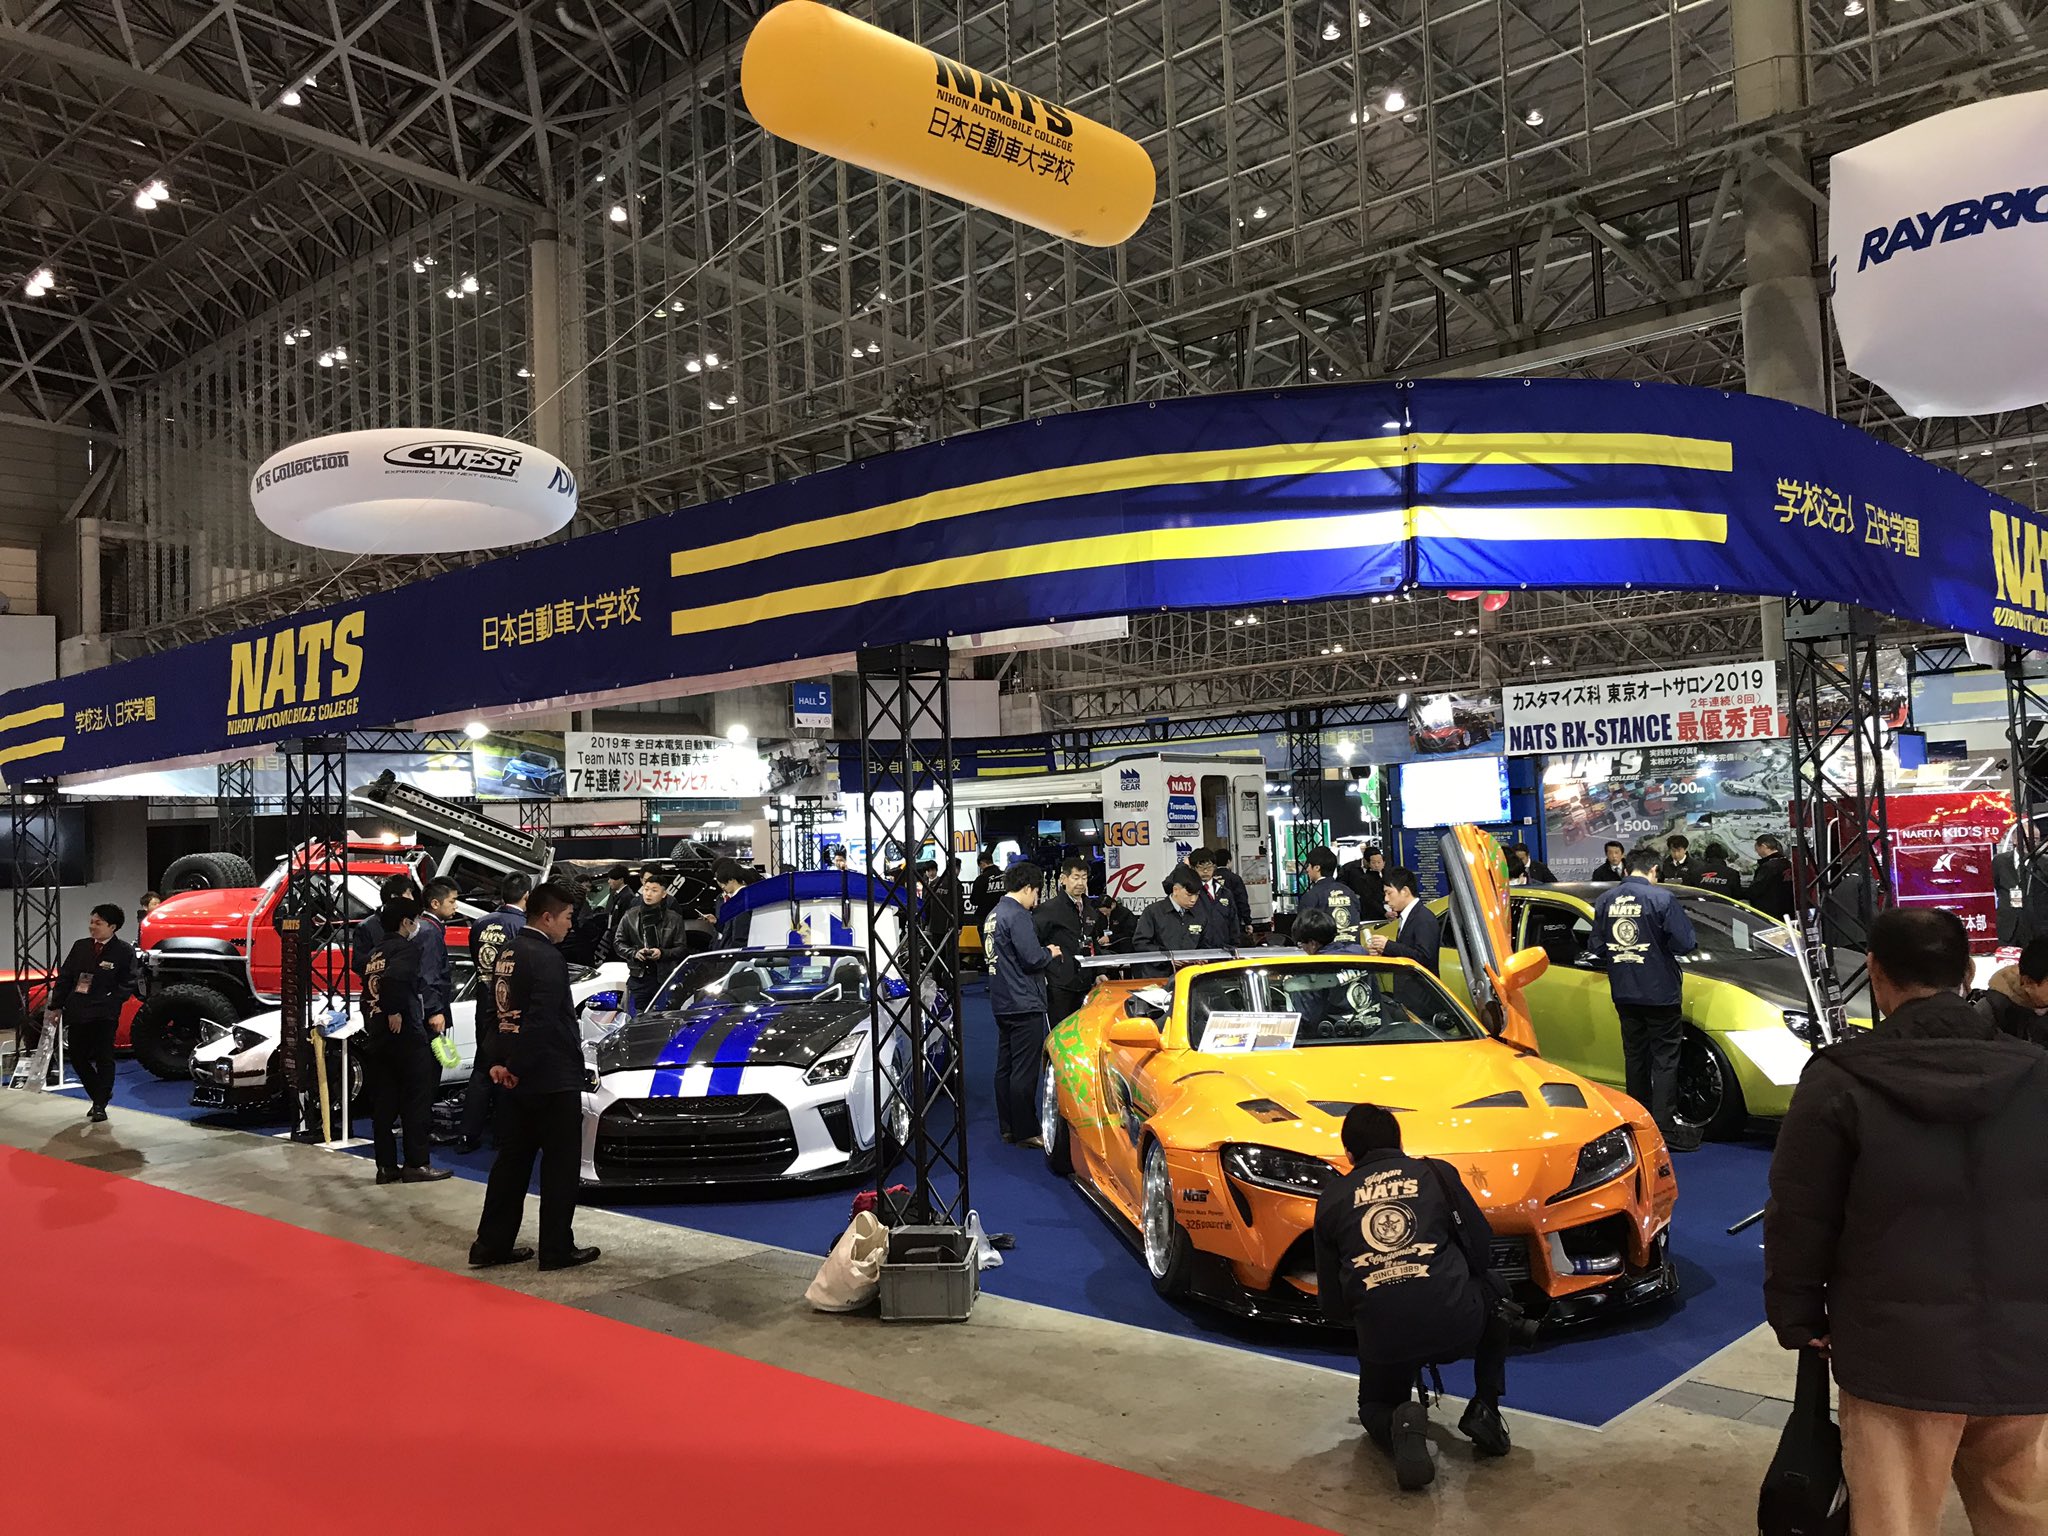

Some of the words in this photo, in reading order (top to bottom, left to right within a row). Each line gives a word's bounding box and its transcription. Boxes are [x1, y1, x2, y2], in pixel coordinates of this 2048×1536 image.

[933, 54, 1073, 138] NATS
[936, 89, 970, 110] NIHON
[971, 103, 1032, 136] AUTOMOBILE
[1034, 129, 1073, 153] COLLEGE
[928, 106, 1075, 185] 日本自動車大学校
[272, 450, 349, 484] Collection
[1774, 477, 1856, 534] 学校法人
[1864, 502, 1920, 558] 日栄学園
[482, 586, 642, 651] 日本自動車大学校
[227, 610, 365, 716] NATS
[1513, 684, 1601, 711] カスタマイズ科
[1607, 669, 1763, 705] 東京オートサロン2019
[798, 697, 818, 706] HALL
[818, 691, 827, 706] 5
[74, 705, 113, 735] 学校法人
[115, 696, 156, 728] 日栄学園
[227, 717, 256, 735] NIHON
[255, 705, 317, 732] AUTOMOBILE
[318, 697, 360, 720] COLLEGE
[1509, 724, 1558, 750] NATS
[1562, 713, 1673, 748] RX-STANCE
[1676, 704, 1774, 742] 最優秀賞
[591, 737, 631, 749] 2019年
[577, 752, 604, 765] Team
[608, 752, 635, 766] NATS
[569, 769, 621, 793] 7年連続
[1171, 781, 1192, 792] NATS
[1658, 782, 1706, 797] 1,200m
[1113, 800, 1149, 809] Silverstone
[1169, 803, 1197, 812] Travelling
[1168, 812, 1196, 821] Classroom
[1613, 820, 1659, 833] 1,500m
[1902, 829, 1941, 839] NARITA
[1942, 826, 1983, 838] KID'S
[1700, 877, 1728, 885] NATS
[1328, 896, 1351, 905] NATS
[1608, 904, 1642, 915] NATS
[282, 919, 300, 930] NATS
[479, 930, 506, 943] NATS
[365, 958, 386, 972] NATS
[496, 961, 515, 973] NATS
[1364, 1169, 1402, 1186] Japan
[1354, 1179, 1418, 1205] NATS
[1372, 1267, 1398, 1281] SINCE
[1399, 1265, 1420, 1275] 1989
